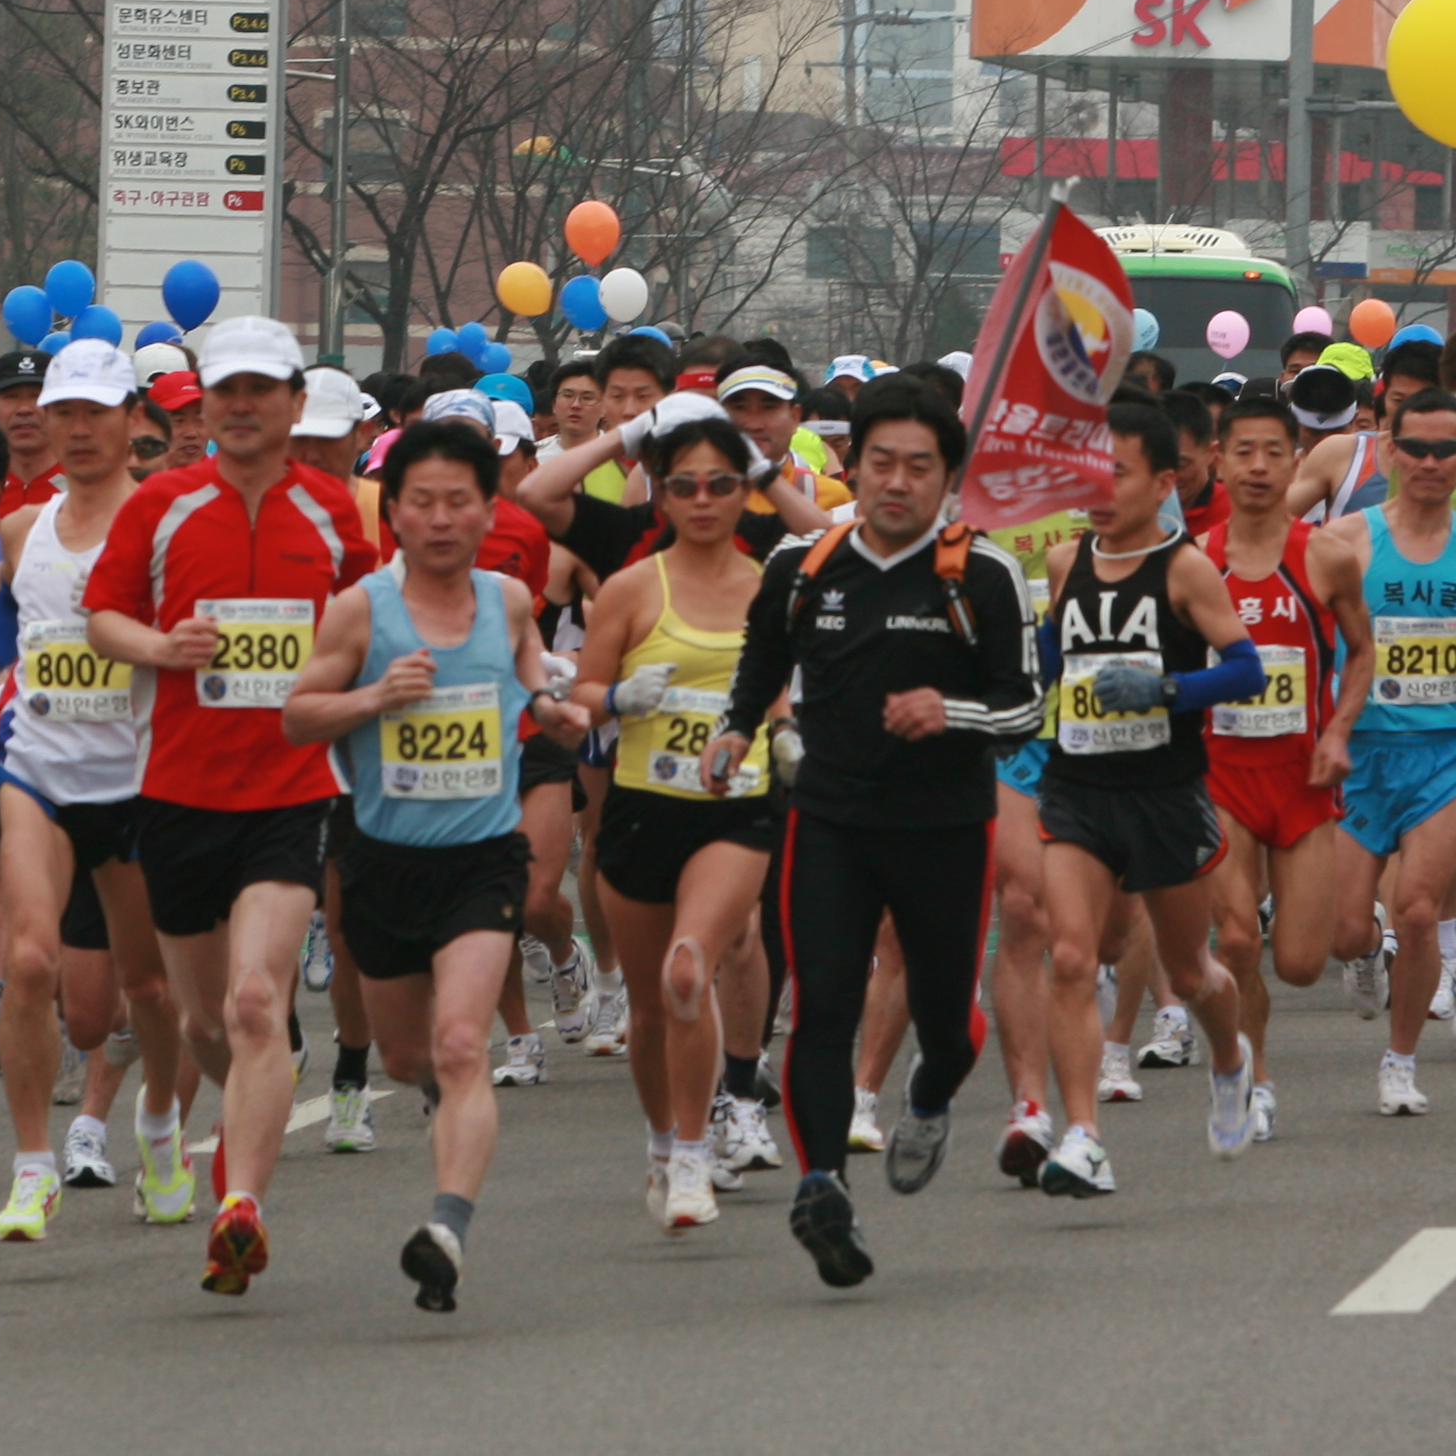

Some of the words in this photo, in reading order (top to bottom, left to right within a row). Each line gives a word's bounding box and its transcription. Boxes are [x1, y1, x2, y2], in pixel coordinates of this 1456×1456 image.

[1060, 591, 1161, 653] AIA
[36, 652, 116, 688] 8007
[210, 633, 300, 671] 2380
[398, 720, 489, 762] 8224
